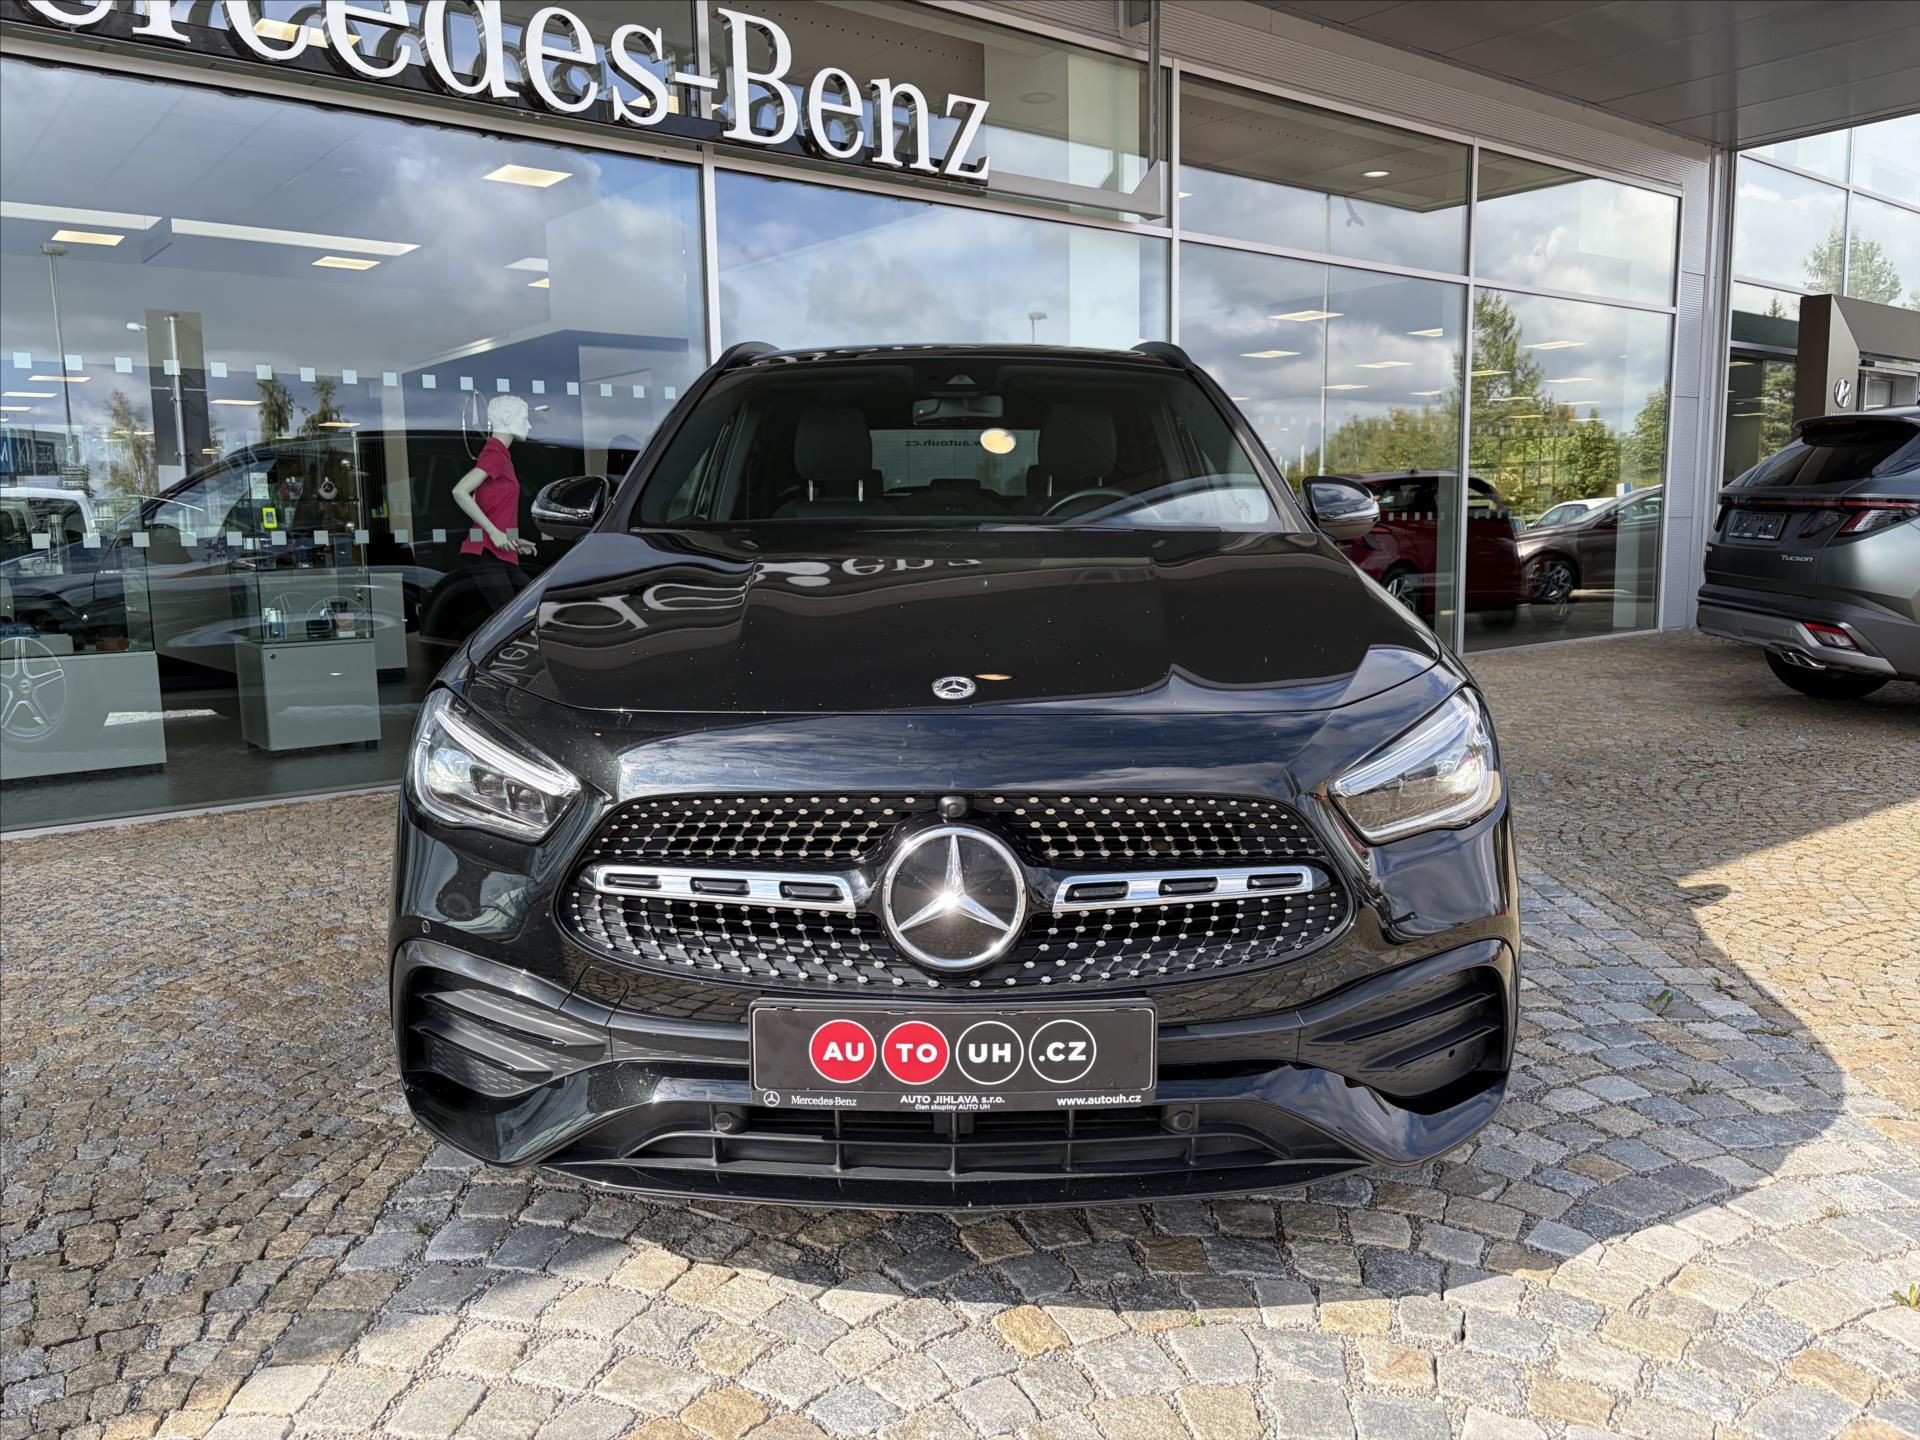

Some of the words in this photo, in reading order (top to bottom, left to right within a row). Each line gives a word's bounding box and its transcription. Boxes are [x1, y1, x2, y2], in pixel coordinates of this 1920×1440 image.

[823, 1042, 864, 1061] AU
[896, 1043, 938, 1063] TO
[968, 1043, 1011, 1063] UH
[1039, 1041, 1086, 1062] .CZ
[791, 1095, 857, 1106] Mercedes-Benz
[900, 1095, 931, 1104] AUTO
[934, 1095, 979, 1104] JIHLAVA
[981, 1096, 1005, 1104] s.r.o.
[1056, 1094, 1142, 1106] www.autouh.cz
